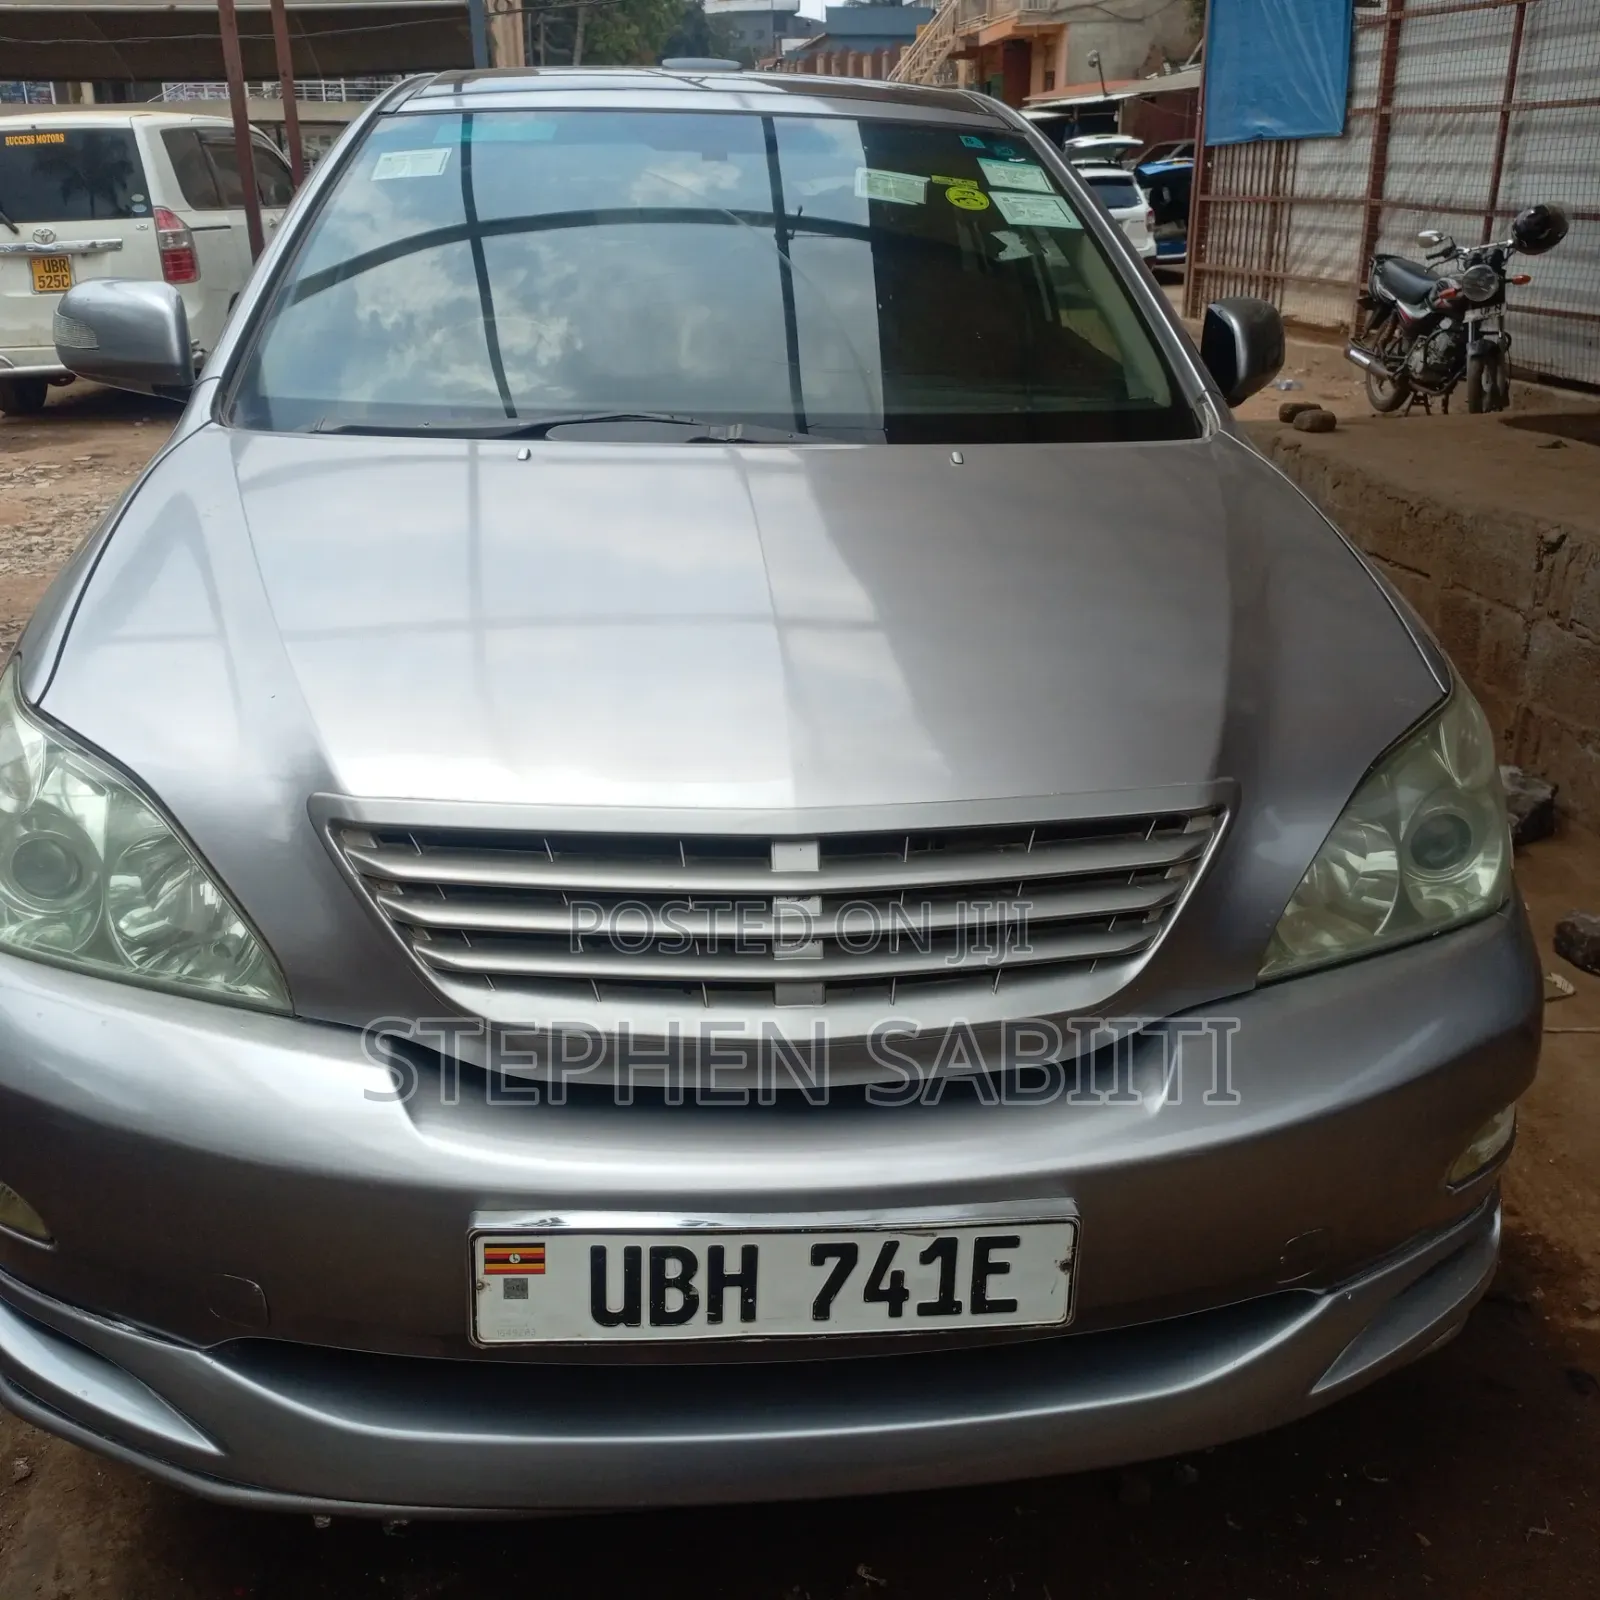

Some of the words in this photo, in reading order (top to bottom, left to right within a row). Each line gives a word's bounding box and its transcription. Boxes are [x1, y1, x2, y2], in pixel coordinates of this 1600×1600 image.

[5, 135, 35, 146] SUCCESS
[36, 133, 65, 144] MOTORS
[42, 258, 68, 273] UBR
[38, 274, 69, 289] 525C
[590, 1243, 759, 1328] UBH
[810, 1235, 1021, 1321] 741E
